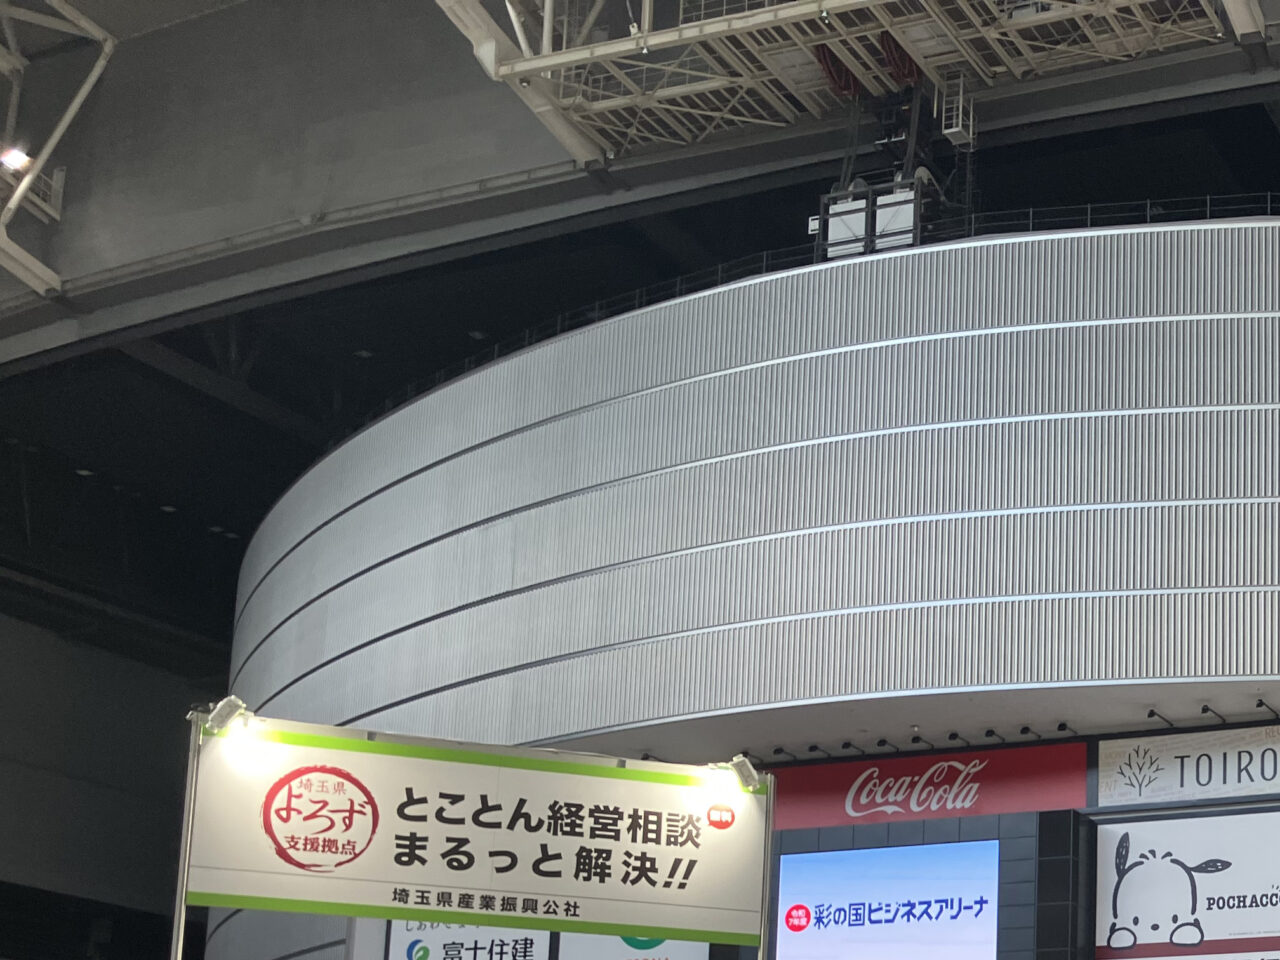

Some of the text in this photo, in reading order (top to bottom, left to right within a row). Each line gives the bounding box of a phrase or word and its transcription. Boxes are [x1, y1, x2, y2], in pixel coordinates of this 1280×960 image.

[296, 777, 348, 795] 埼玉県
[1173, 747, 1278, 788] TOIRO
[845, 758, 989, 817] Coca-Cola
[274, 783, 370, 834] よろず
[396, 786, 702, 849] とことん経営相談
[283, 834, 358, 856] 支援拠点
[391, 887, 581, 918] 埼玉県産業振興公社
[813, 896, 989, 930] 彩の国ビジネスアリーナ
